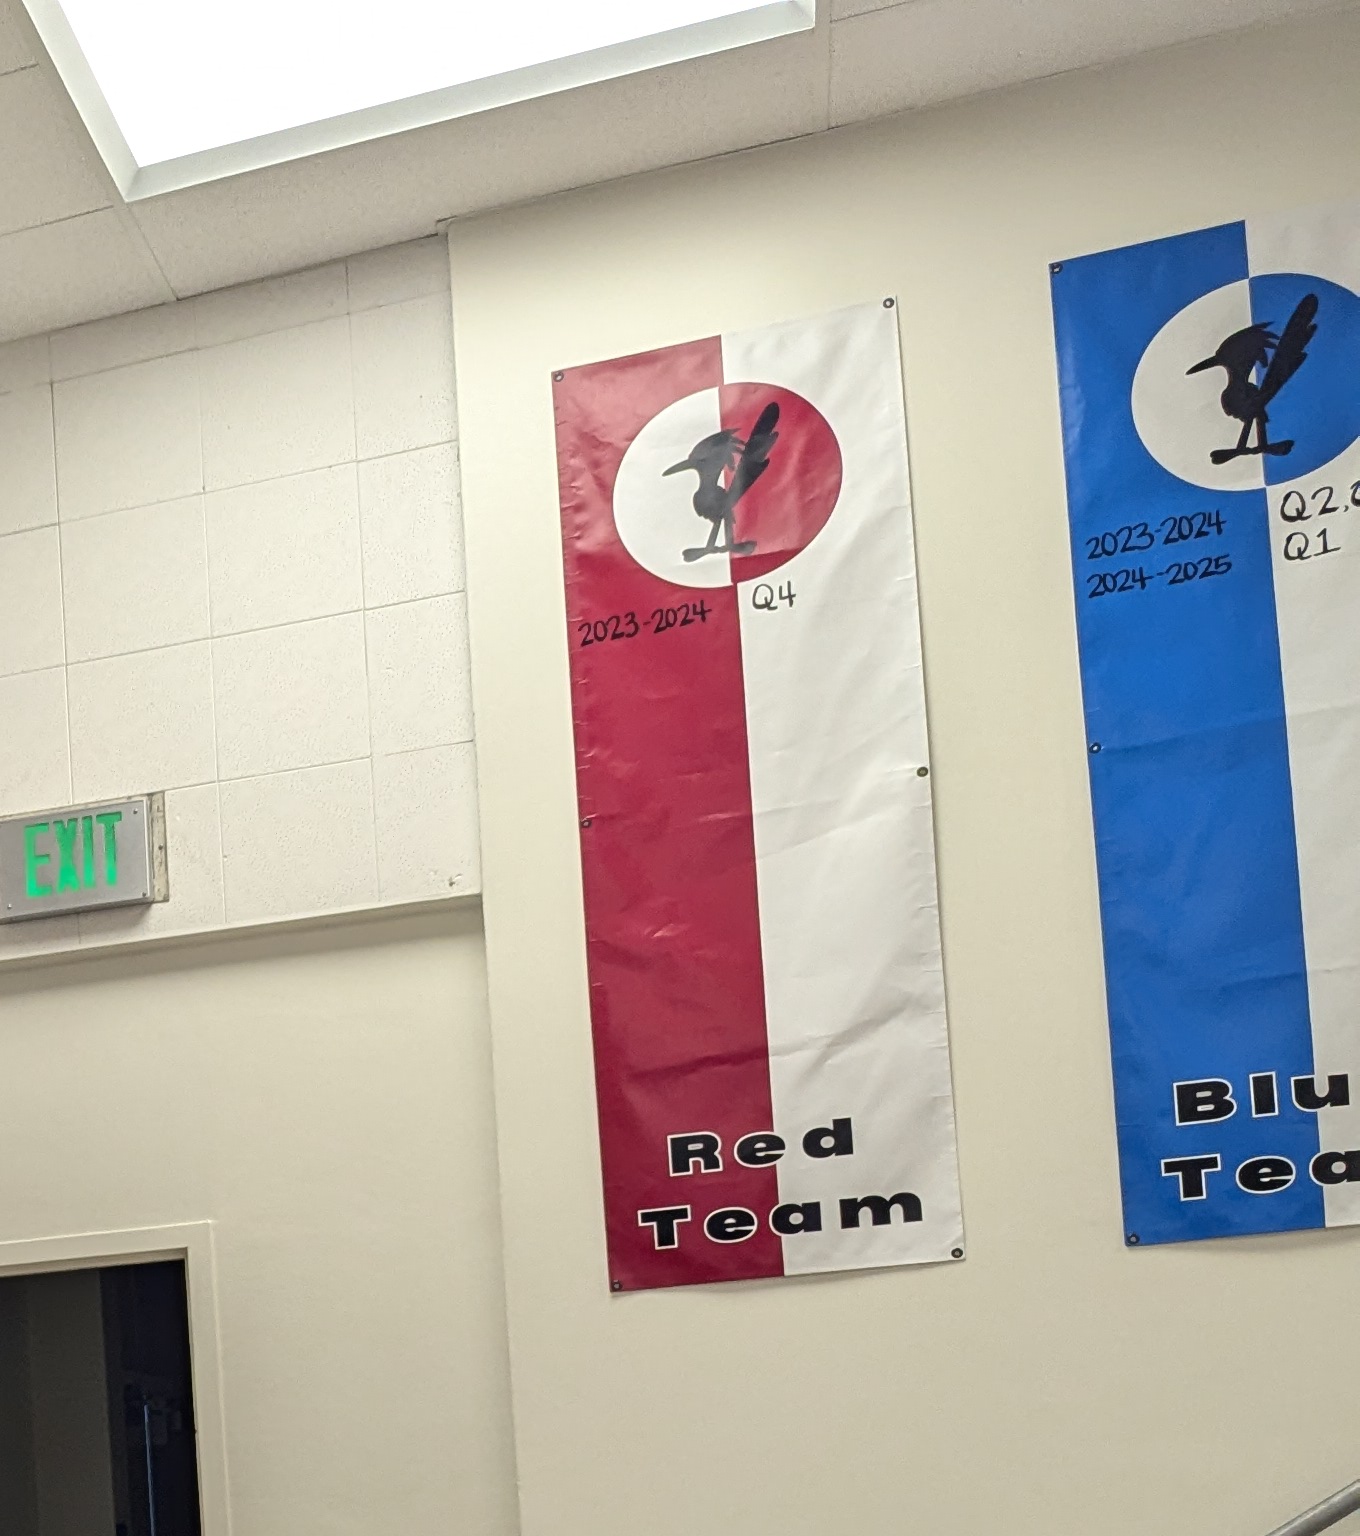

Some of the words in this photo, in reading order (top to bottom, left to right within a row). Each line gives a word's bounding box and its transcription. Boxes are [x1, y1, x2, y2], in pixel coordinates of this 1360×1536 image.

[1086, 509, 1226, 561] 2023-2024
[1087, 554, 1233, 599] 2024-2025
[1283, 528, 1341, 561] Q1
[579, 600, 713, 647] 2023-2024
[751, 580, 797, 613] Q4
[24, 811, 122, 898] EXIT
[1173, 1071, 1351, 1127] Blu
[668, 1117, 854, 1177] Red
[1161, 1152, 1360, 1201] Tea
[638, 1189, 923, 1250] Team
